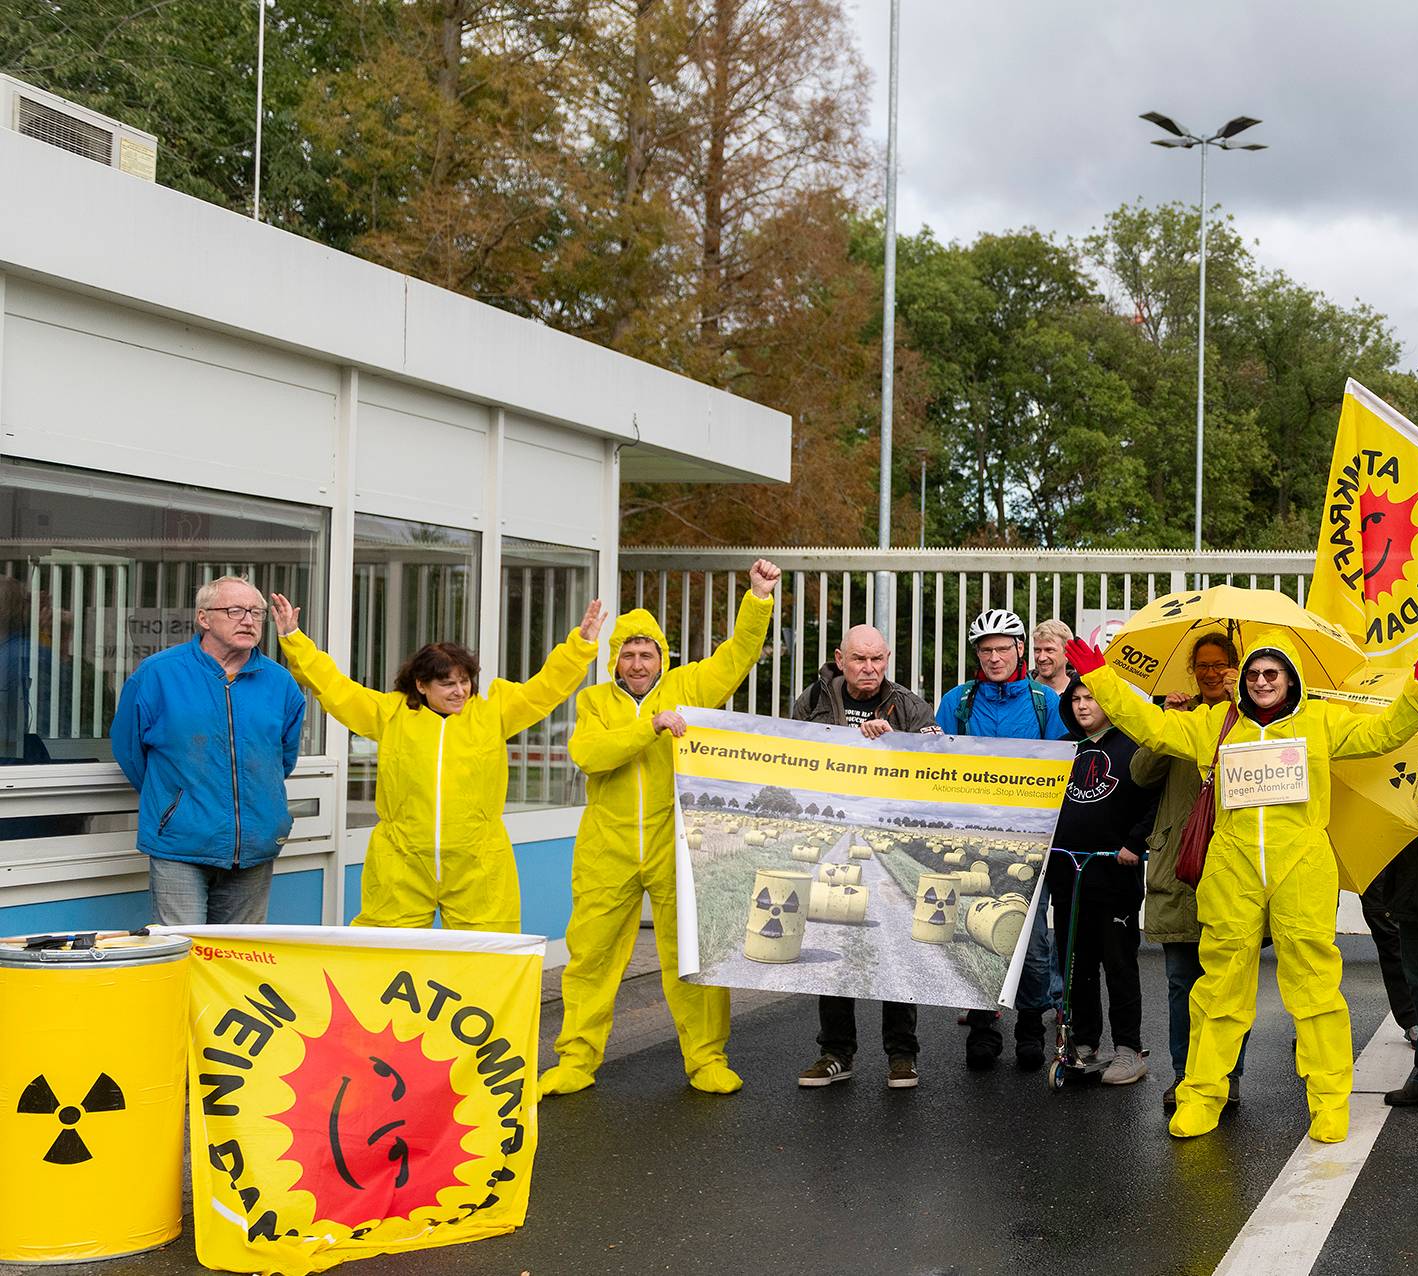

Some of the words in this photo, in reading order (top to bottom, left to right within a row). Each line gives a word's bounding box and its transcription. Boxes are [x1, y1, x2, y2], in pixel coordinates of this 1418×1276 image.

[679, 741, 819, 772] „Verantwortung
[826, 758, 867, 776] kann
[873, 766, 909, 779] man
[915, 767, 957, 782] nicht
[963, 769, 1065, 788] outsourcen“
[1226, 764, 1304, 784] Wegberg
[1228, 786, 1255, 798] gegen
[191, 944, 277, 965] sgestrahlt
[199, 983, 297, 1117] NEIN
